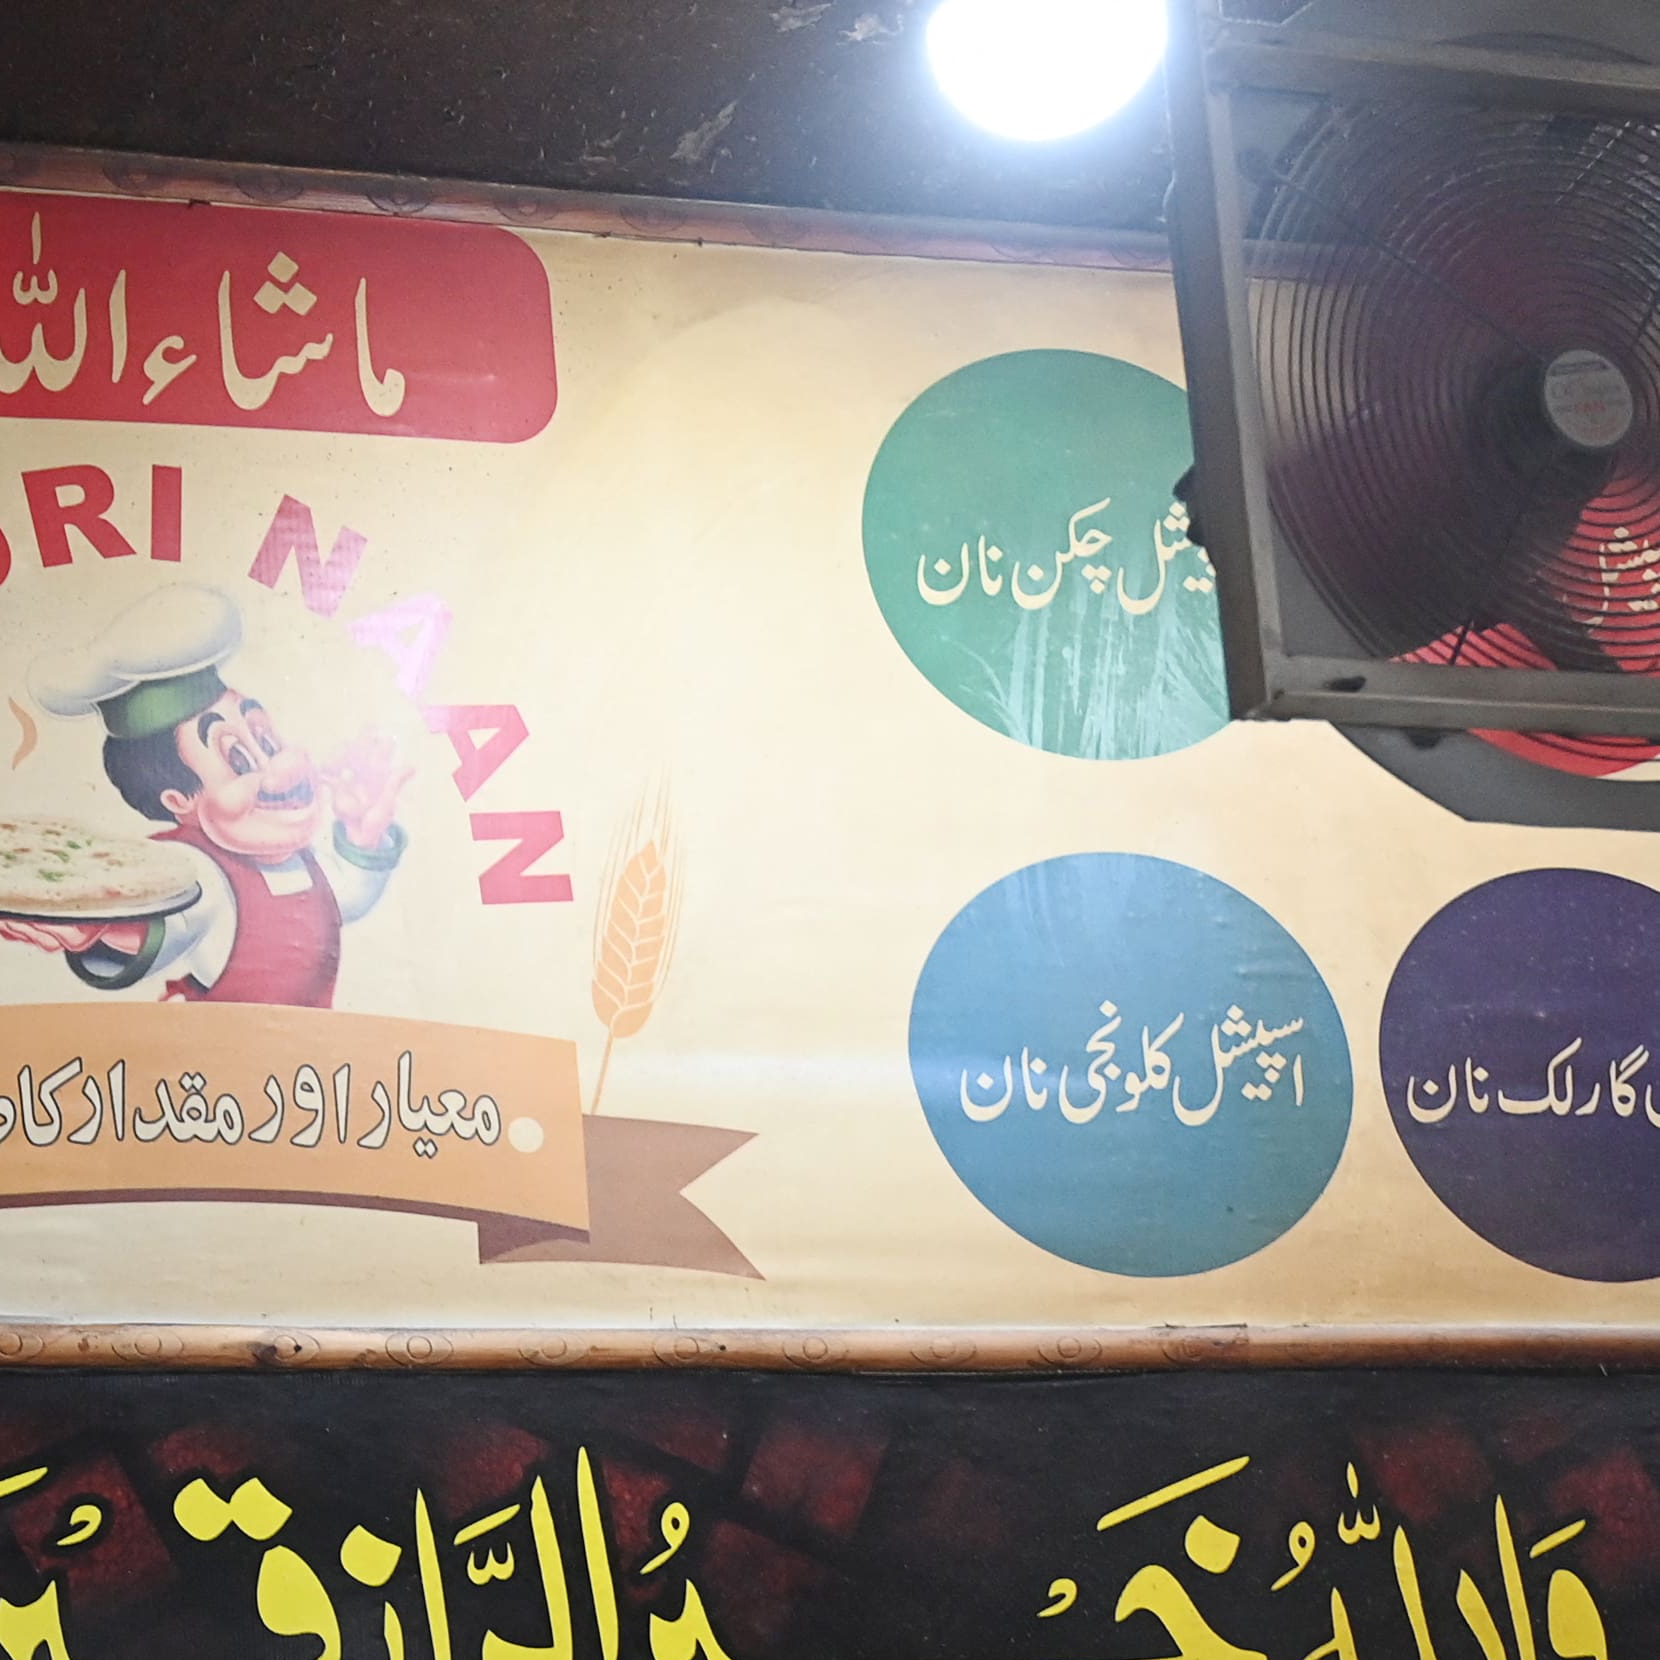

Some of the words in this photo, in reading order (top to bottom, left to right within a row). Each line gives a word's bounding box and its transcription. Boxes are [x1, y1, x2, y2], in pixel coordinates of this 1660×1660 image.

[918, 534, 1003, 605] نان
[1011, 497, 1113, 609] چکن
[247, 492, 575, 906] NAAN
[16, 1055, 84, 1148] کا
[68, 1058, 245, 1146] مقدار
[247, 1062, 351, 1148] اور
[357, 1050, 502, 1159] معیار
[960, 1048, 1048, 1122] نان
[1059, 1000, 1184, 1124] کلونجی
[1172, 1004, 1304, 1126] اسپیشل
[1407, 1057, 1490, 1124] نان
[1497, 1037, 1649, 1117] گارلک
